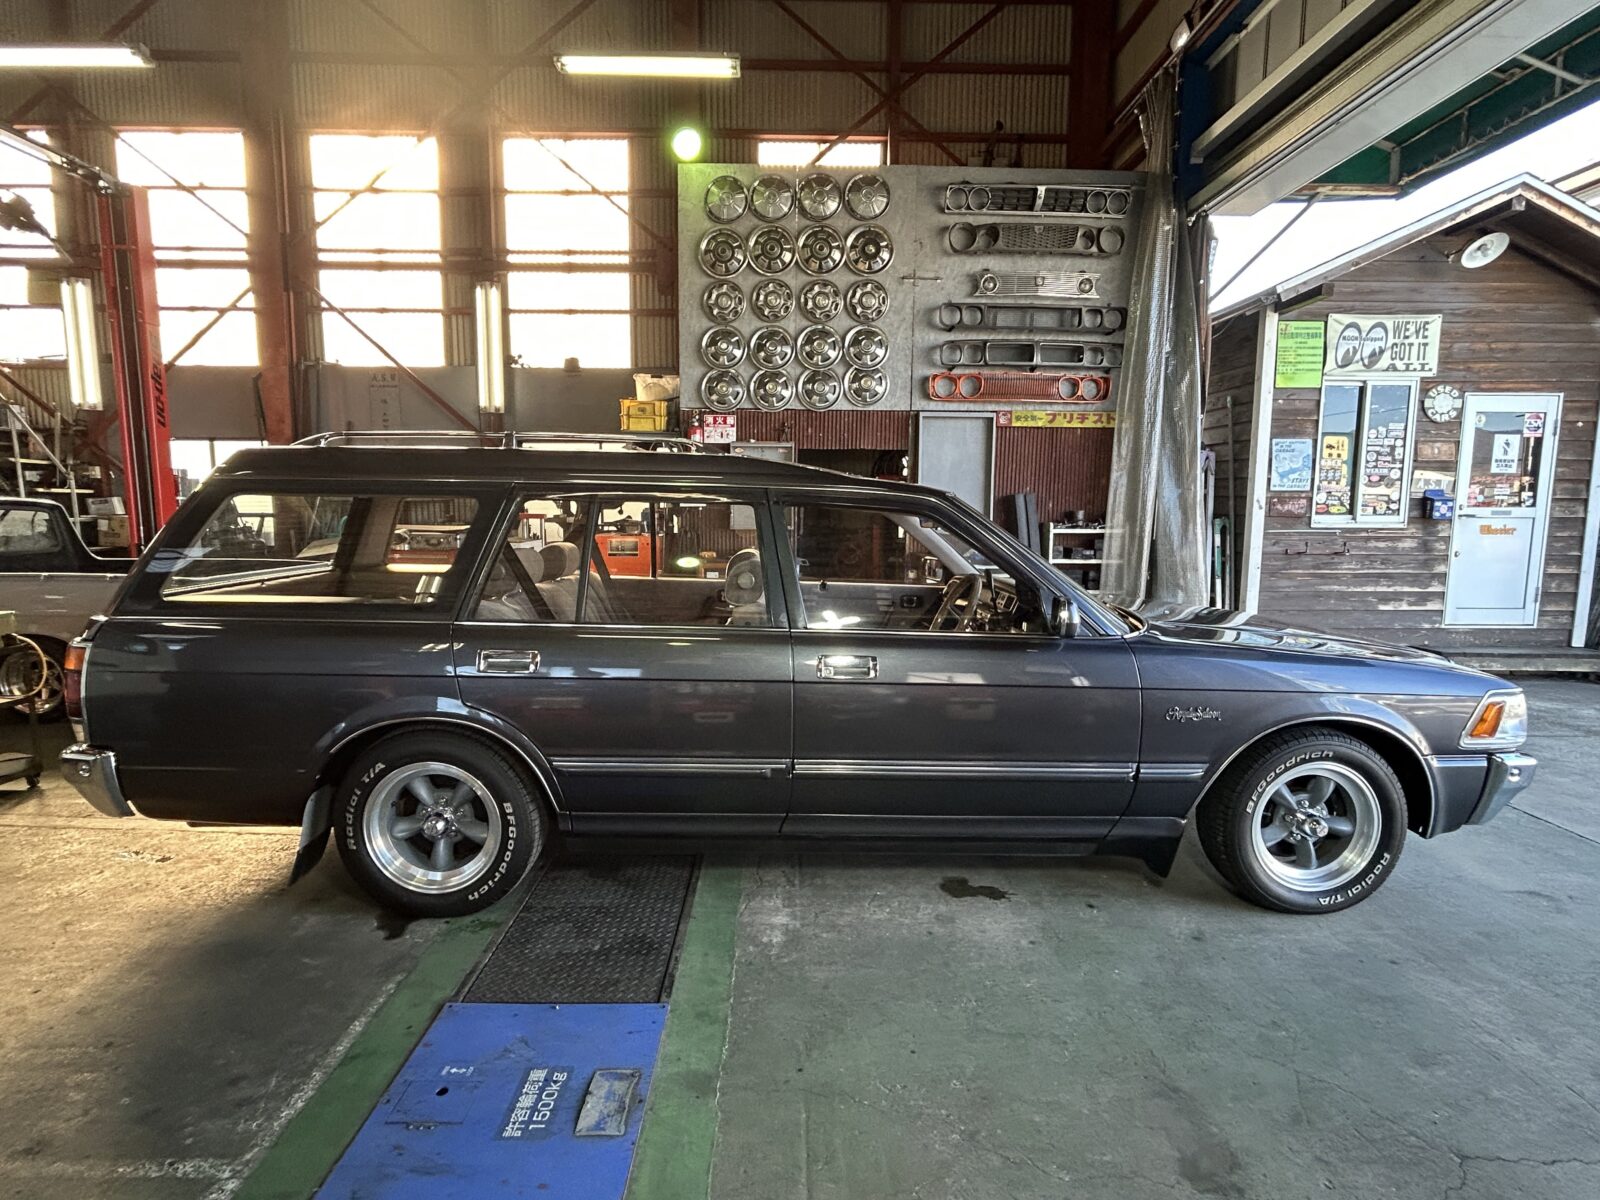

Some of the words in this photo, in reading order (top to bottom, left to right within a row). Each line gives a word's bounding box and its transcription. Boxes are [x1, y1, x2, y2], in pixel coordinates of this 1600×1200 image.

[1393, 320, 1430, 339] WE'VE
[1390, 342, 1414, 361] GOT
[1417, 342, 1430, 361] IT
[1382, 363, 1433, 372] ALL
[1428, 384, 1459, 398] USED
[705, 415, 736, 426] 消火器
[1427, 408, 1457, 422] CARS
[1246, 750, 1334, 814] BFGoodrich
[345, 788, 361, 850] Radial
[361, 762, 386, 783] T/A
[468, 803, 517, 900] BFGoodrich
[1347, 852, 1390, 897] Radial
[1319, 894, 1345, 905] T/A
[503, 1068, 548, 1137] 許容輪荷重
[529, 1072, 568, 1131] 1500kg
